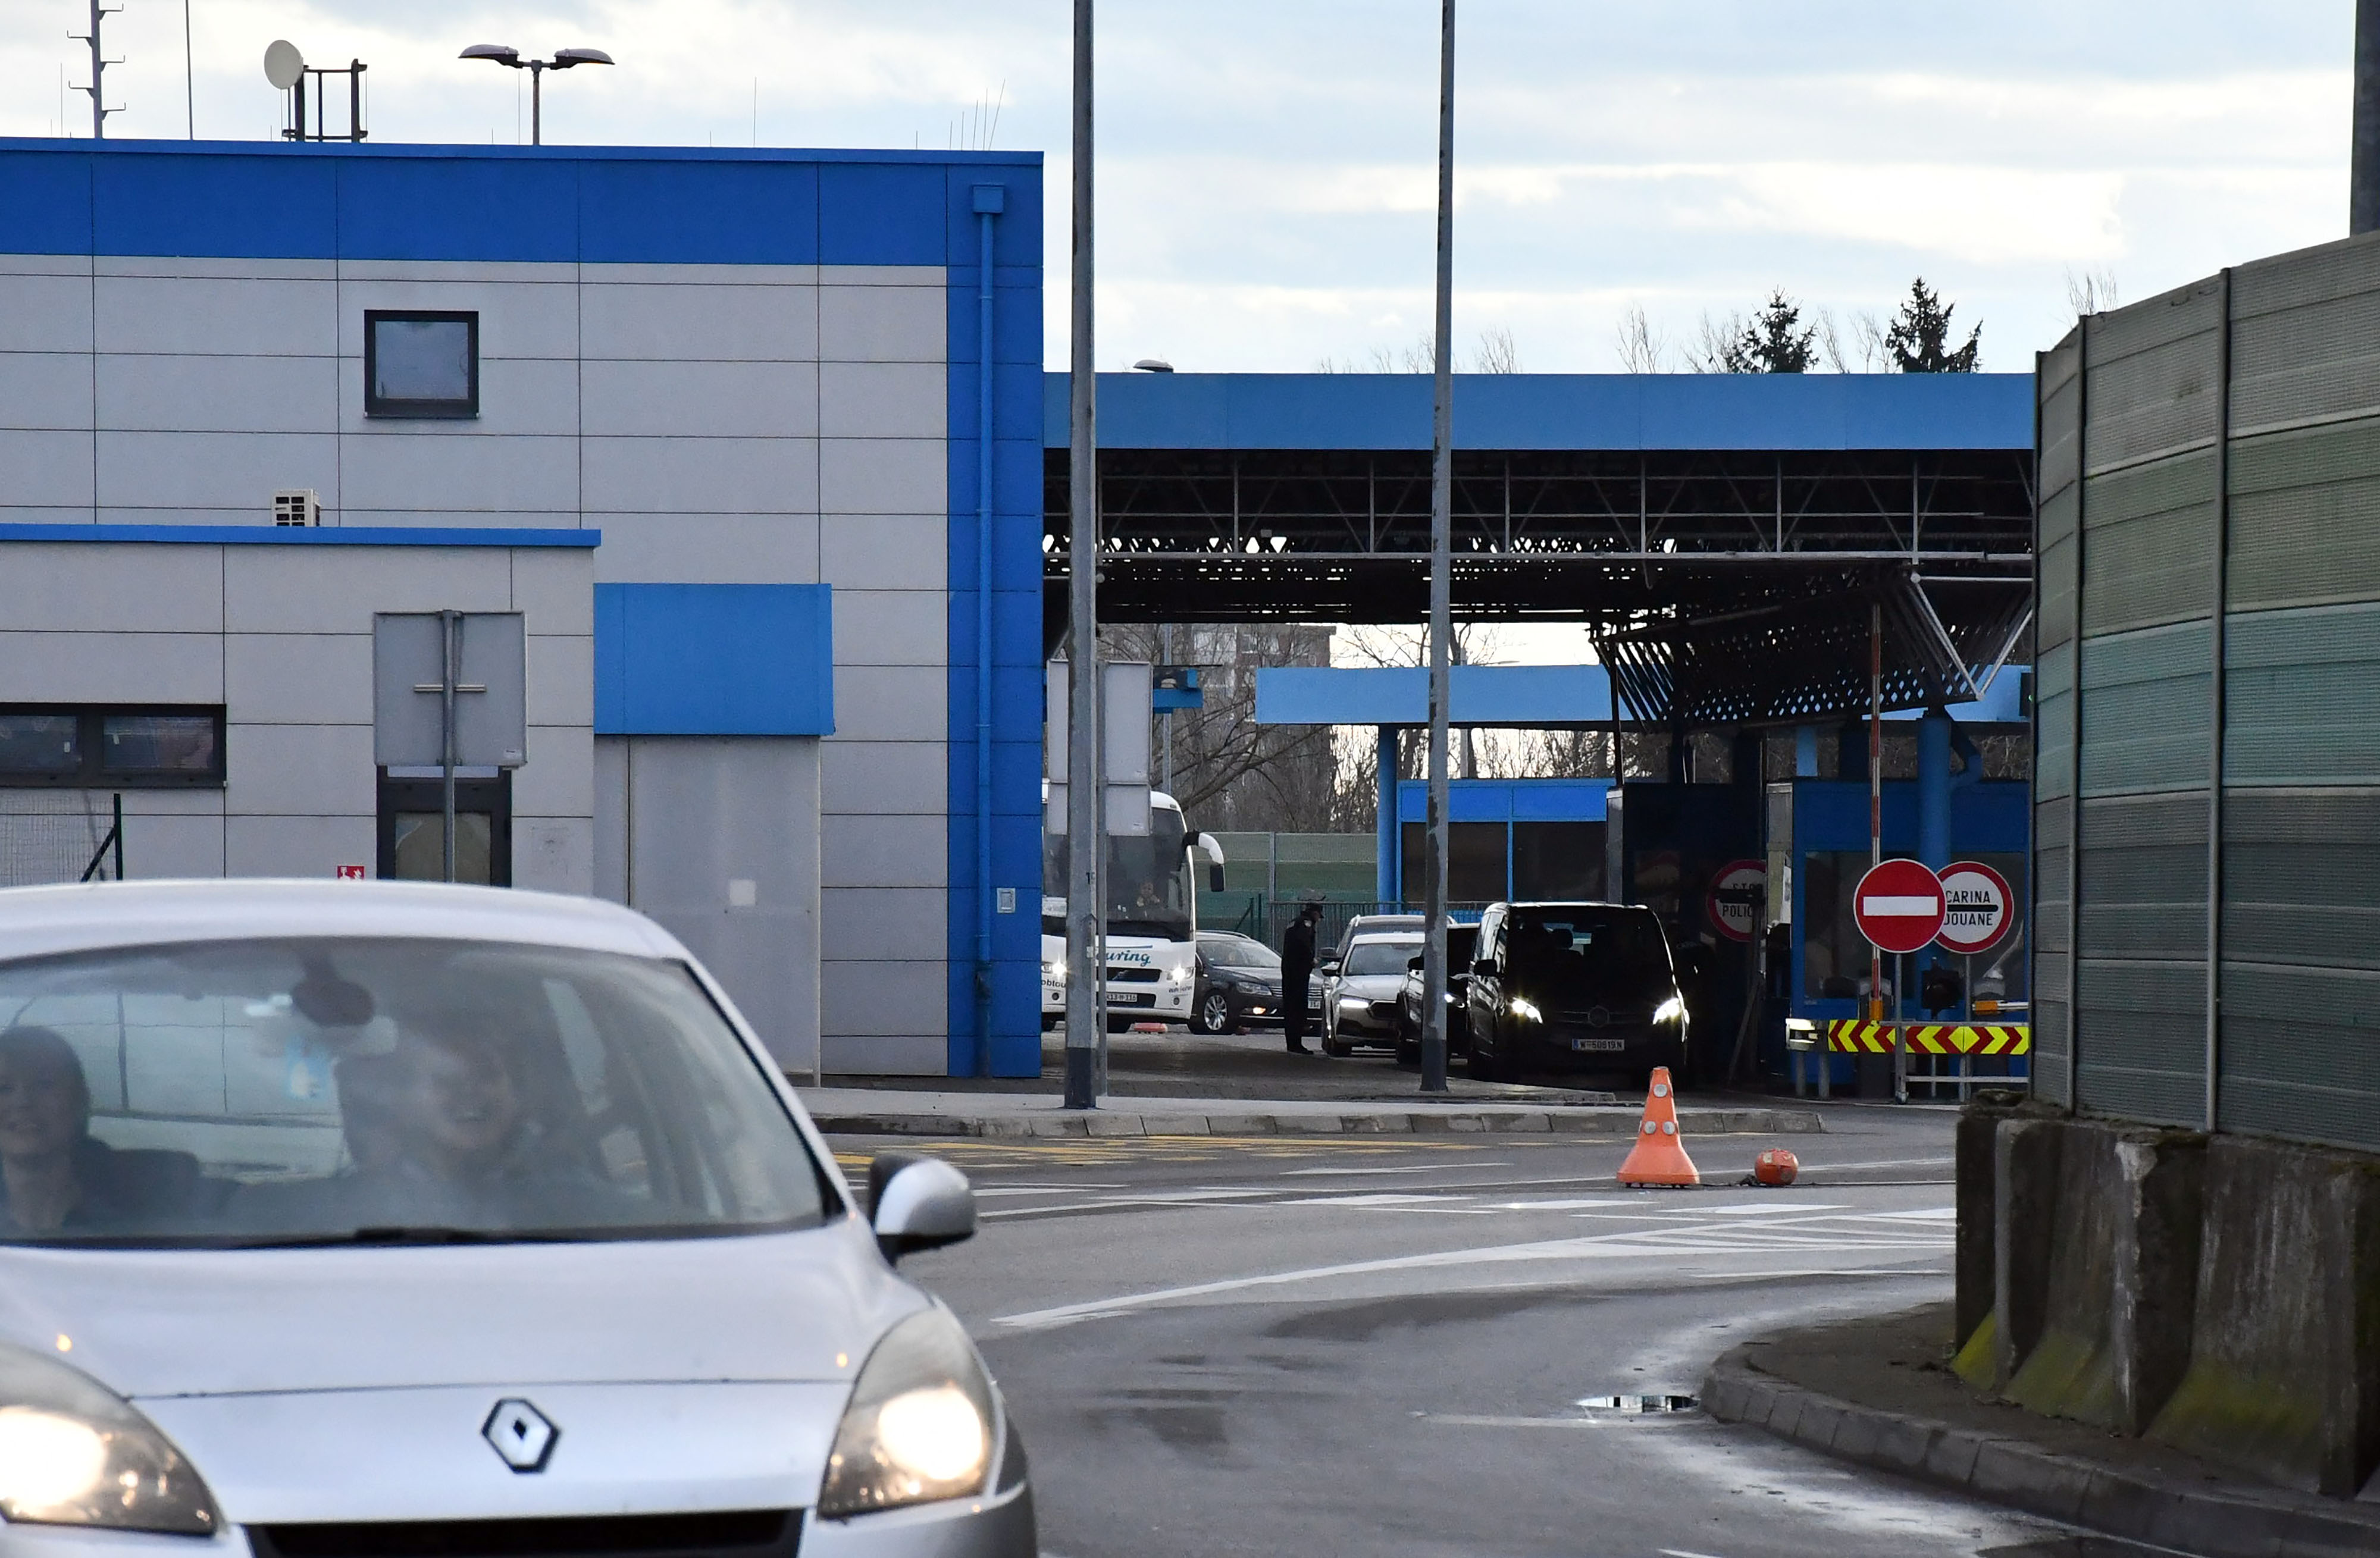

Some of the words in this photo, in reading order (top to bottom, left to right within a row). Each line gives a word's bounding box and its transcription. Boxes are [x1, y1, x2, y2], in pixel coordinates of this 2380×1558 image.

[1946, 891, 1990, 903] CARINA
[1723, 905, 1753, 917] POLIC
[1944, 913, 1993, 926] DOUANE
[1097, 950, 1151, 967] uring
